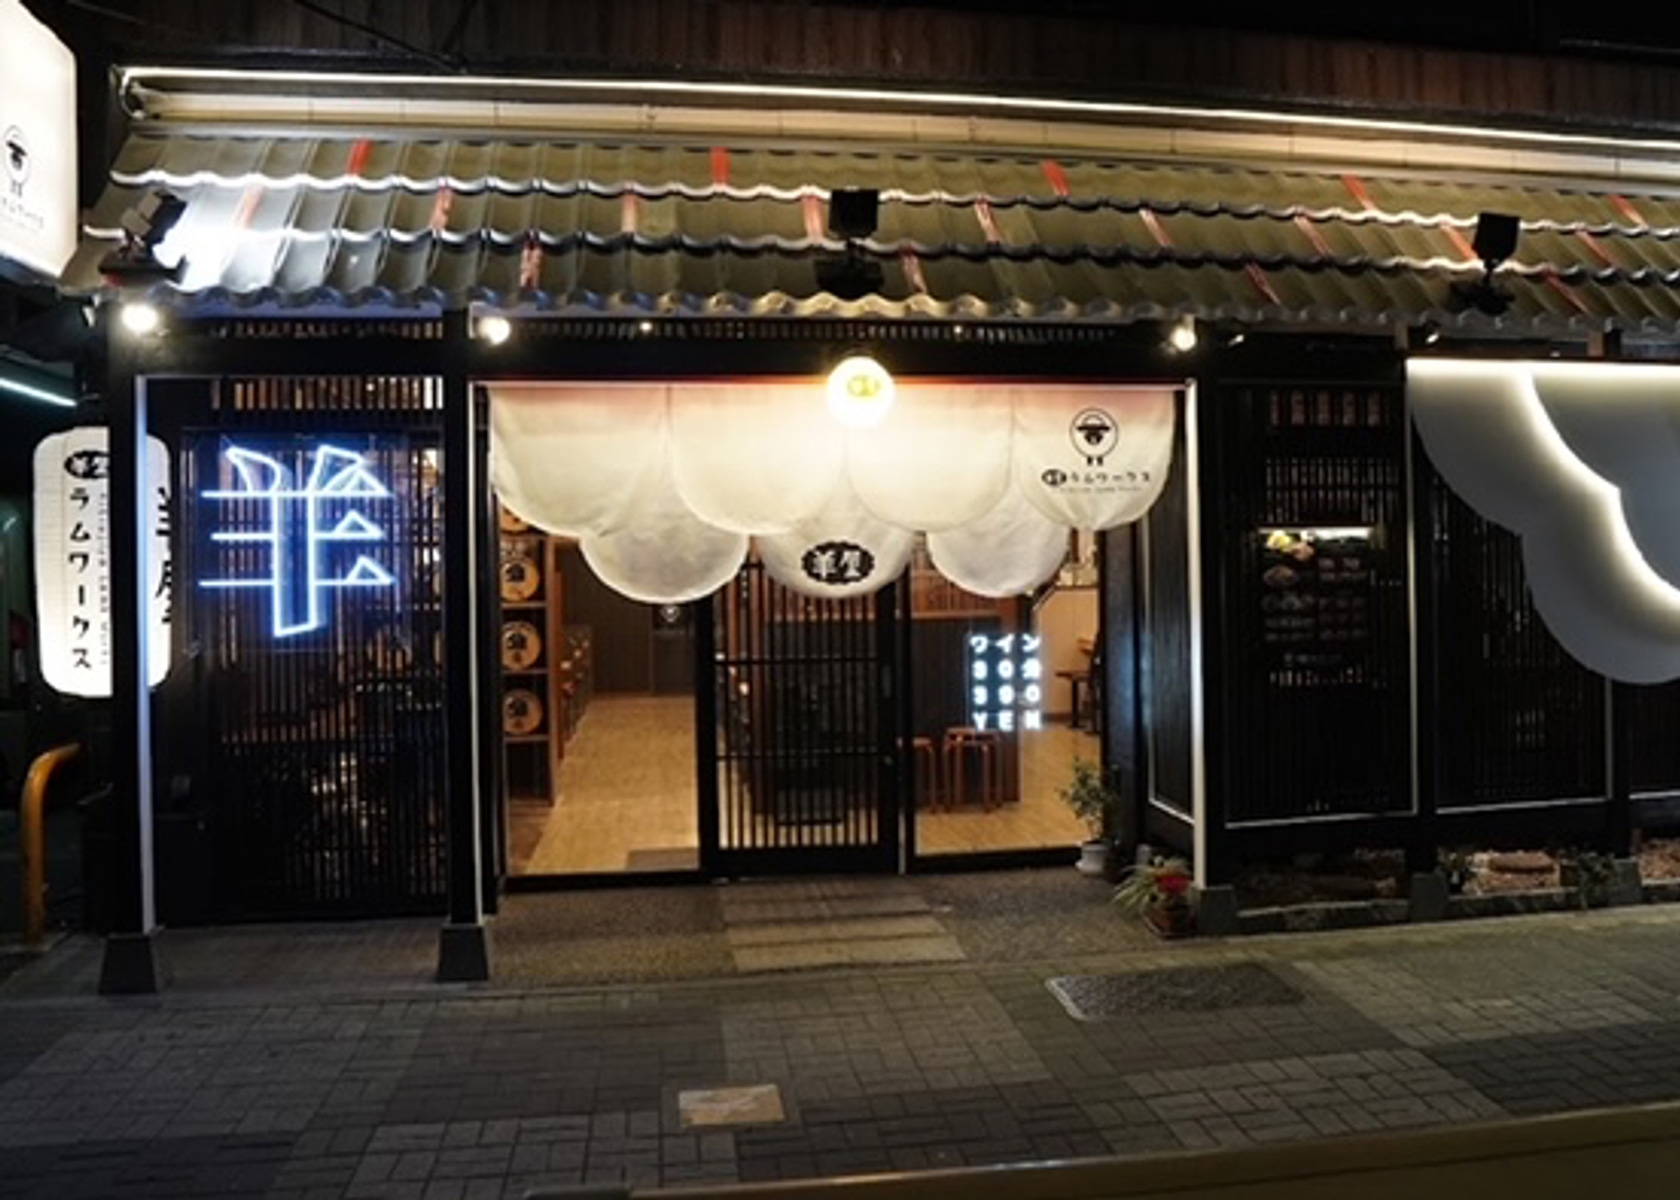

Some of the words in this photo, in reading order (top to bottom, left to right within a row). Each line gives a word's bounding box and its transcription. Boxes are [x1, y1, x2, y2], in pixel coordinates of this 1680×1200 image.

[68, 487, 92, 669] ラムワークス
[198, 443, 396, 638] 羊
[969, 633, 1041, 654] ワイン
[972, 710, 1041, 732] YEN
